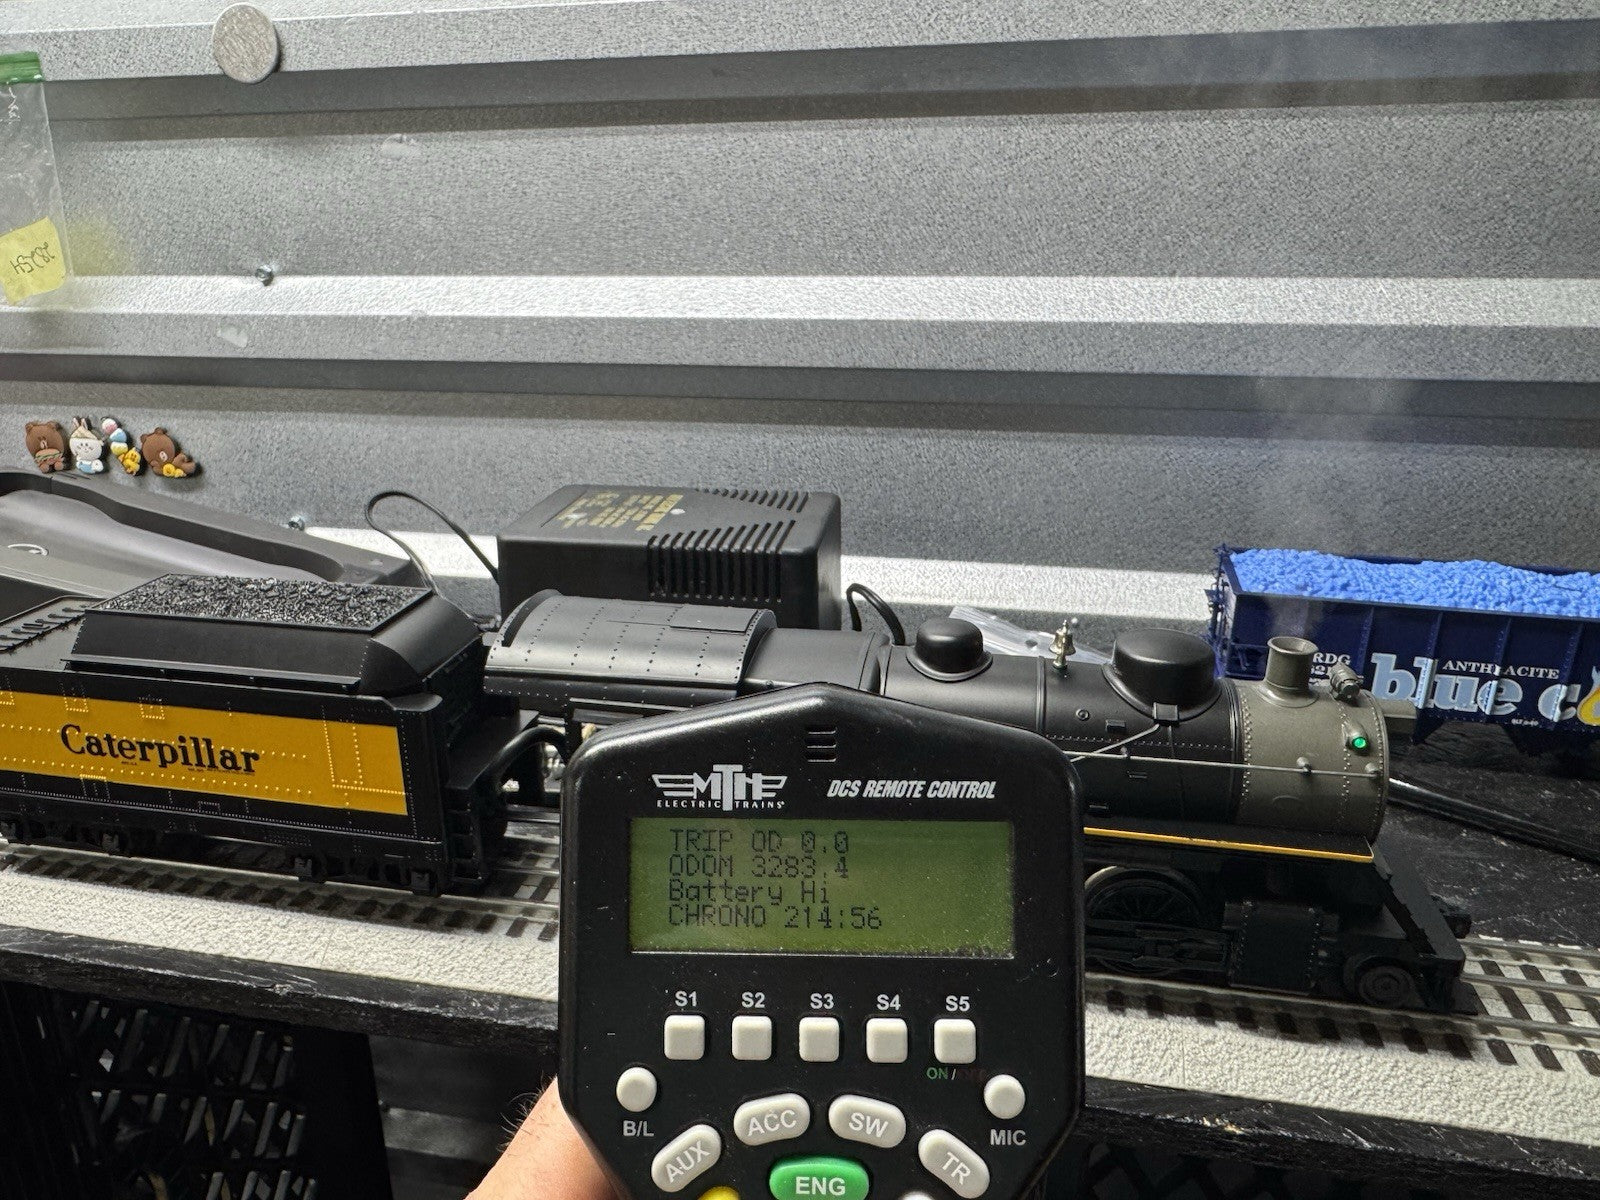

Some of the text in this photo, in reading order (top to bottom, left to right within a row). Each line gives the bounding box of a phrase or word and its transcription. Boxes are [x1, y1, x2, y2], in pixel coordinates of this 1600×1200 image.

[1312, 652, 1351, 665] RDG
[1371, 653, 1523, 716] blue
[60, 724, 260, 773] Caterpillar
[690, 764, 768, 811] MTH
[827, 780, 996, 799] DCS REMOTE CONTROL
[656, 799, 721, 809] ELECTRIC
[669, 828, 849, 853] TRIP OD 0.0
[669, 854, 849, 878] ODOM 3283.4
[669, 878, 829, 906] Battery Hi
[669, 903, 883, 930] CHRONO 214:56
[675, 991, 698, 1007] S1
[741, 992, 766, 1008] S2
[810, 993, 834, 1009] S3
[876, 994, 901, 1011] S4
[945, 995, 970, 1011] S5
[622, 1120, 655, 1137] B/L
[748, 1109, 797, 1137] ACC
[848, 1112, 889, 1138] SW
[990, 1129, 1026, 1146] MIC
[664, 1140, 711, 1183] AUX
[941, 1152, 971, 1185] TR
[795, 1176, 846, 1196] ENG
